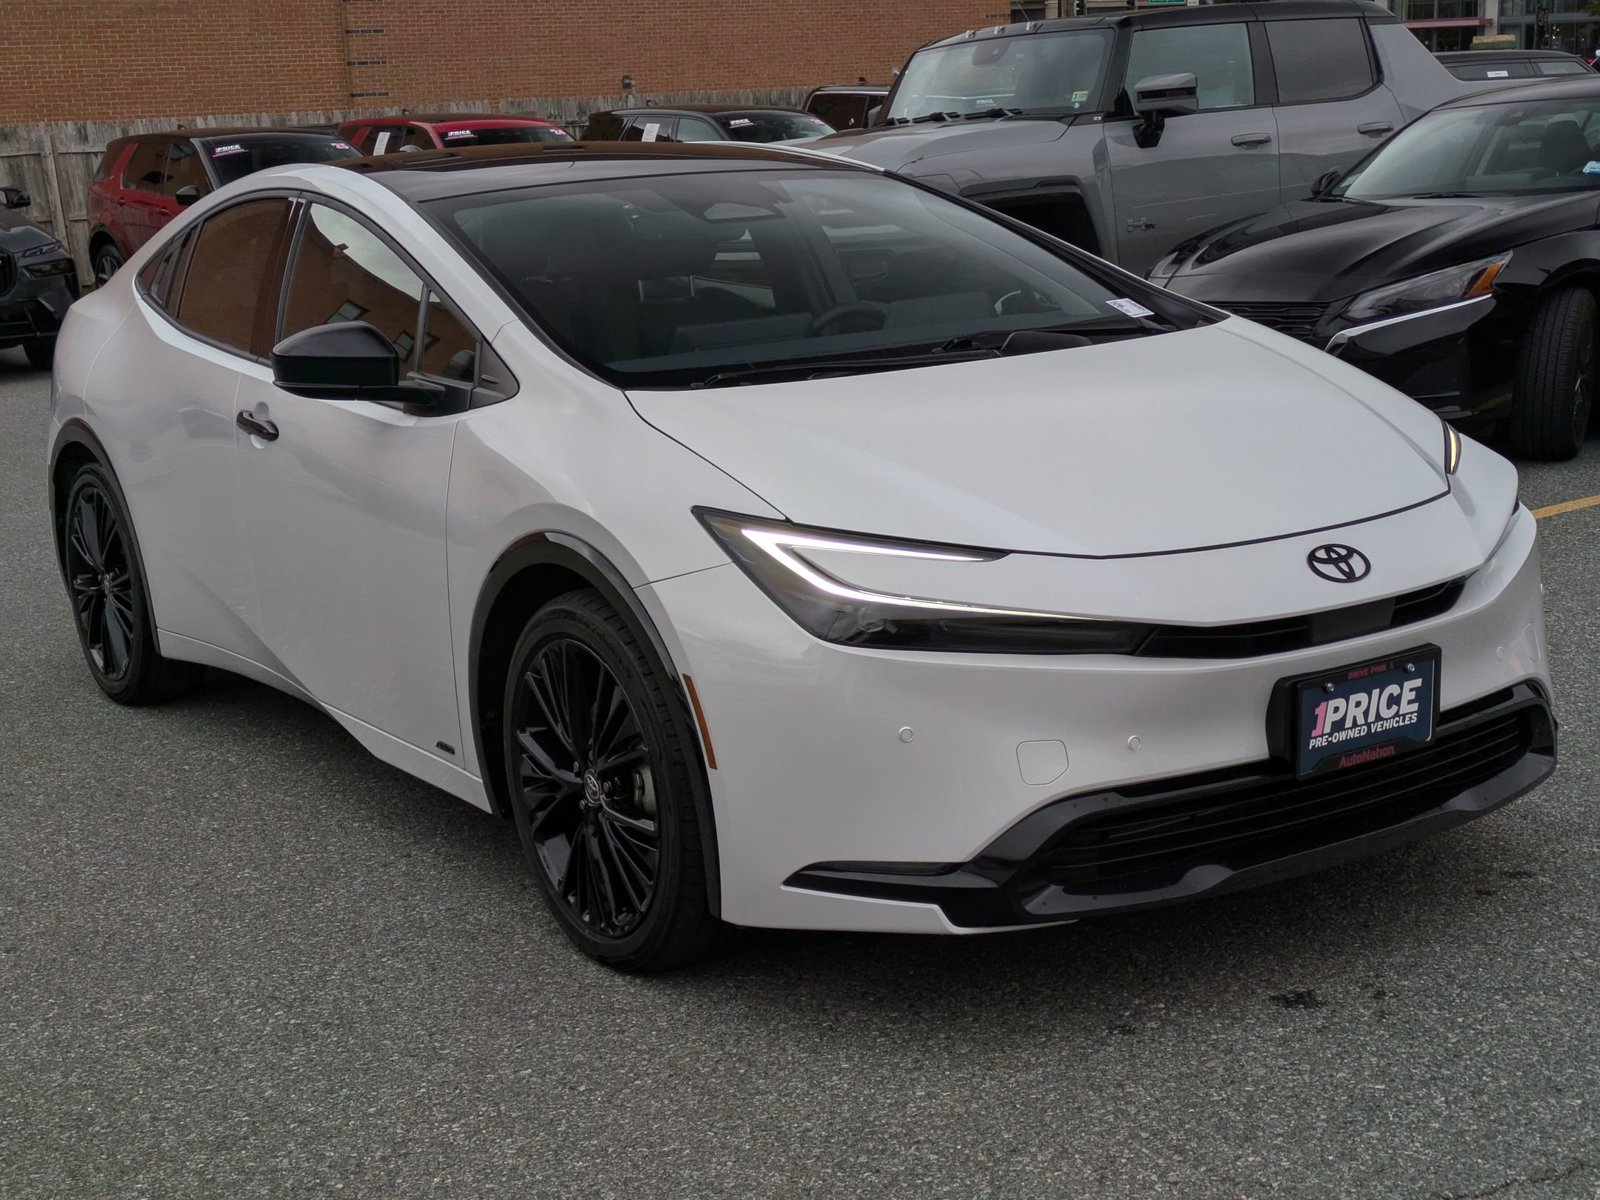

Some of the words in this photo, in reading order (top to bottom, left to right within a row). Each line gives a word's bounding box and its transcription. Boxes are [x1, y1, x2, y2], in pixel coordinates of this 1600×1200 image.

[1311, 678, 1422, 737] 1PRICE
[1309, 725, 1368, 750] PRE-OWNED
[1370, 712, 1418, 734] VEHICLES
[1338, 745, 1395, 769] AutoNation
